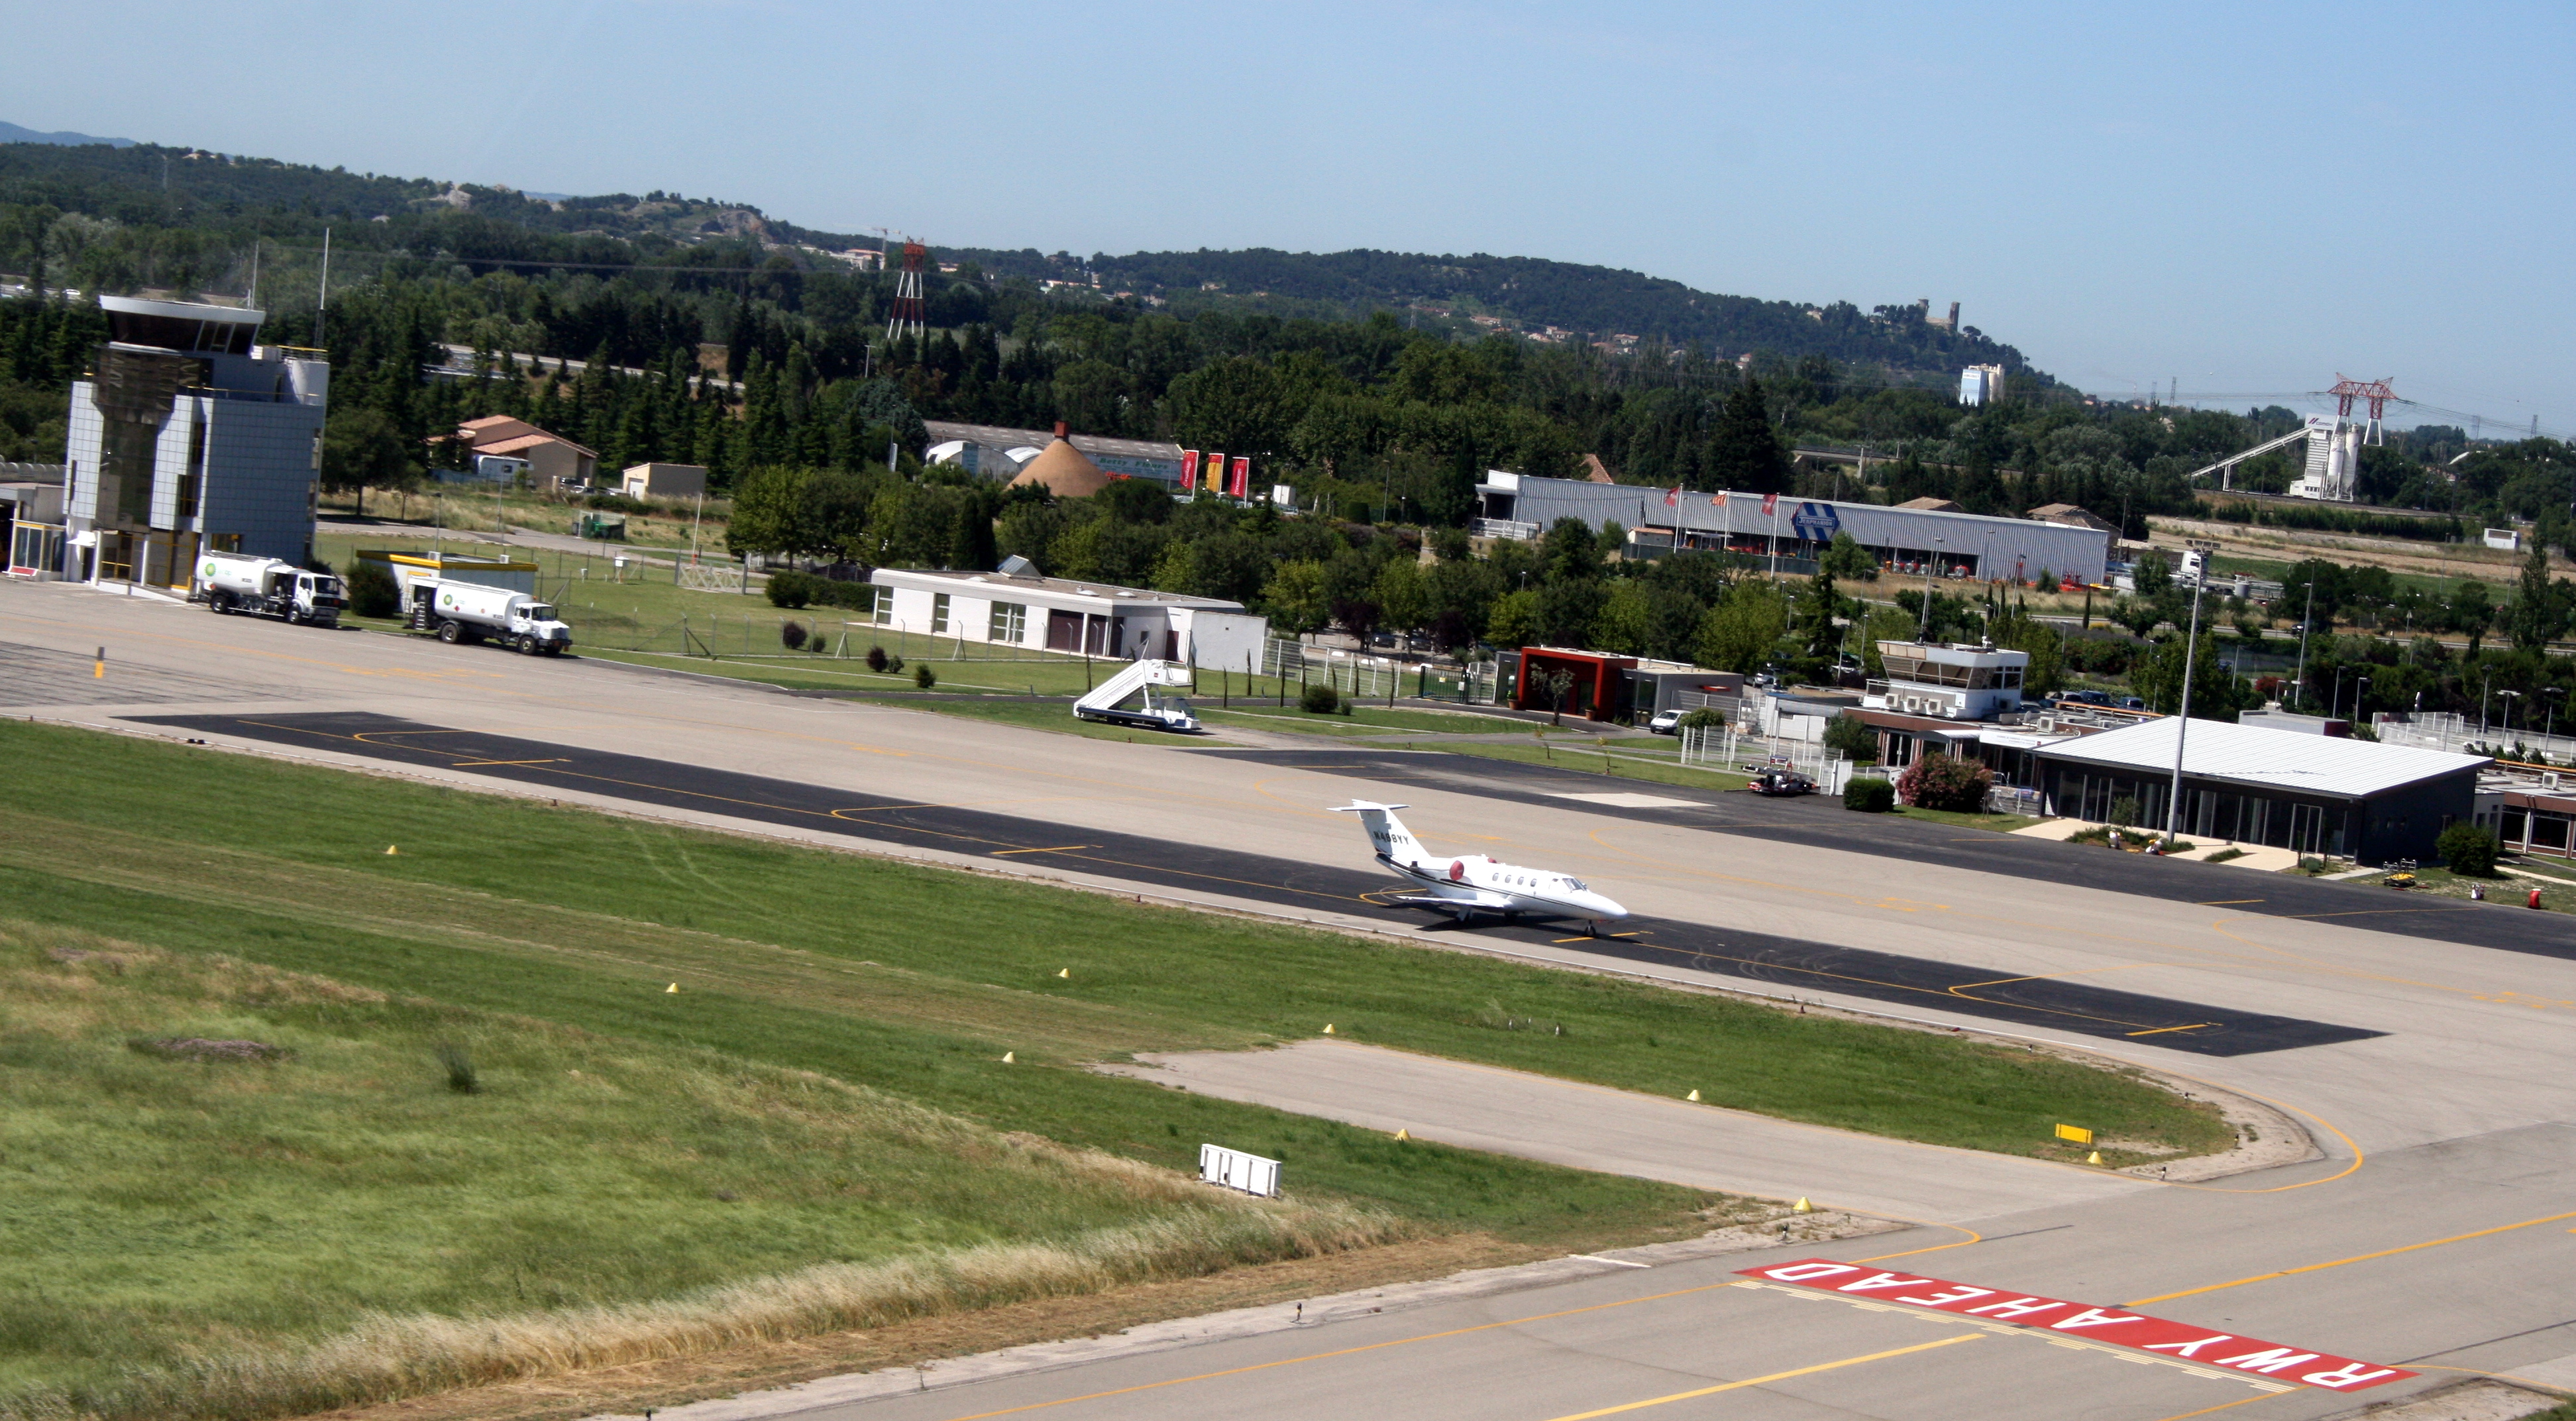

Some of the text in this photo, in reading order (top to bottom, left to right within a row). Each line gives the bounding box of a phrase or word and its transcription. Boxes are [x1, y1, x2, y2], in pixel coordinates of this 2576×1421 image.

[1099, 457, 1127, 466] Betty
[1135, 461, 1168, 469] Fleurs
[1373, 830, 1409, 845] N488YY
[1764, 1263, 2396, 1388] RWY AHEAD
